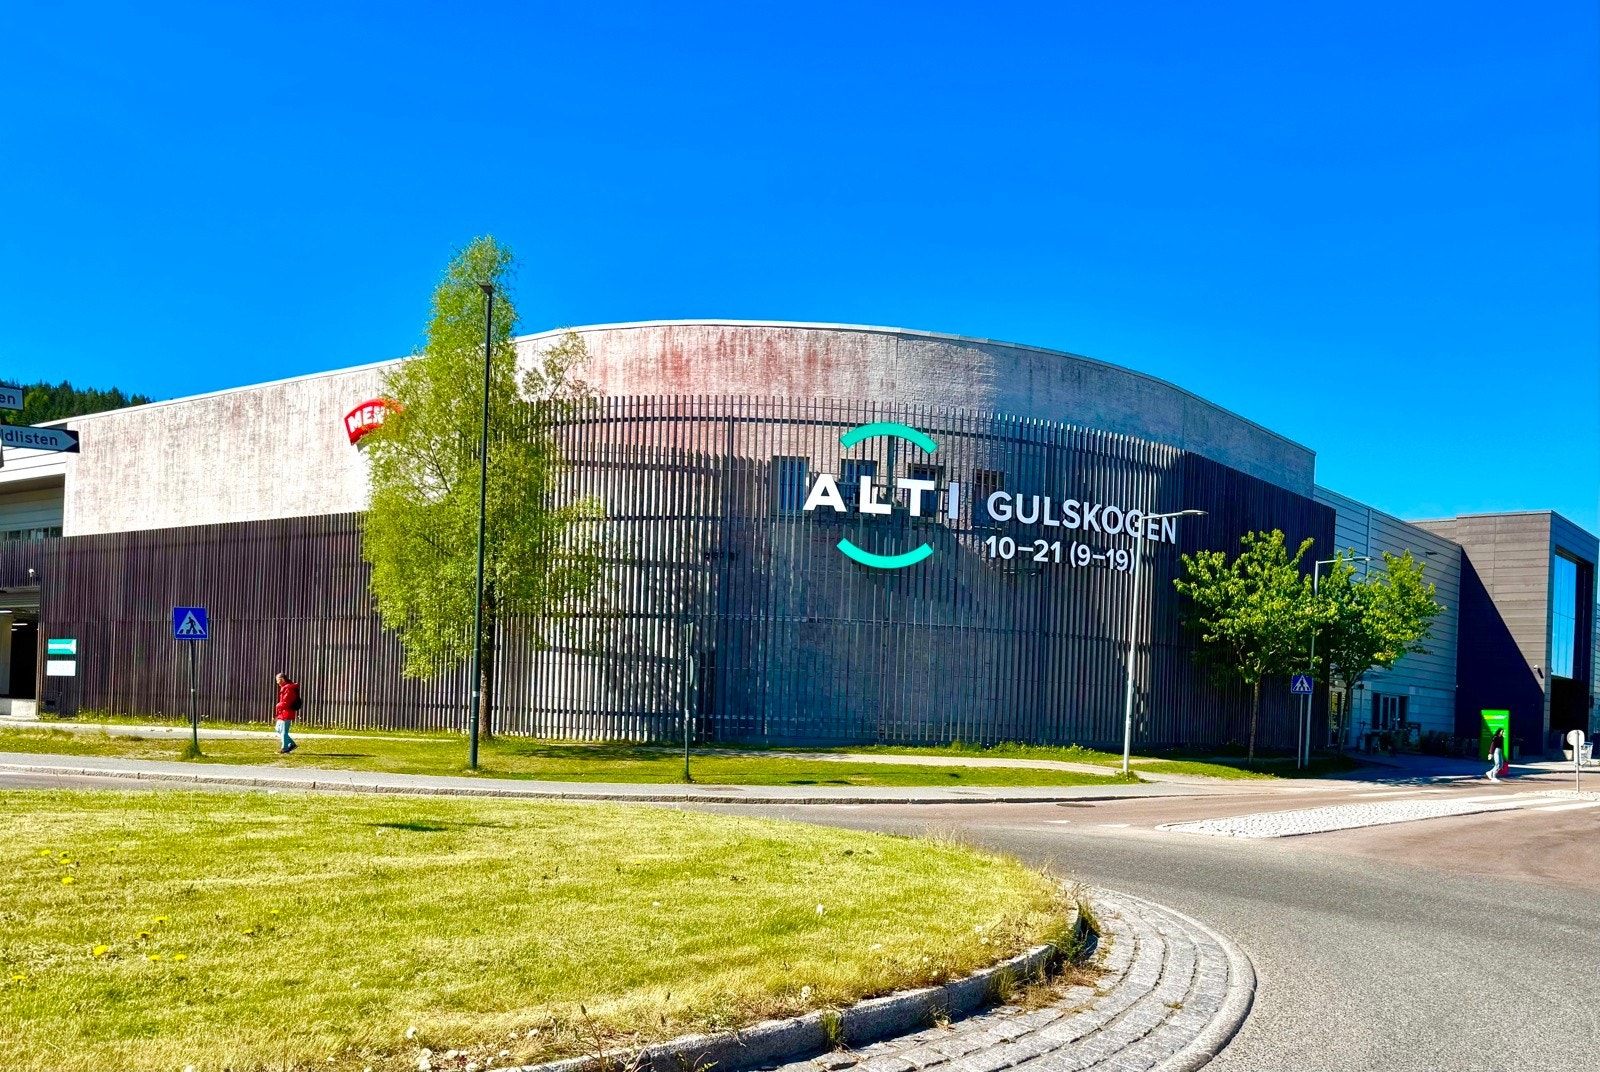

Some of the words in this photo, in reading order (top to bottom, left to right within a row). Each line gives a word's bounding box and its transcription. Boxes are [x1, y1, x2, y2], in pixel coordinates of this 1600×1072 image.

[347, 405, 390, 434] MEN
[802, 473, 960, 520] ALTI
[986, 490, 1177, 545] GULSKOGEN
